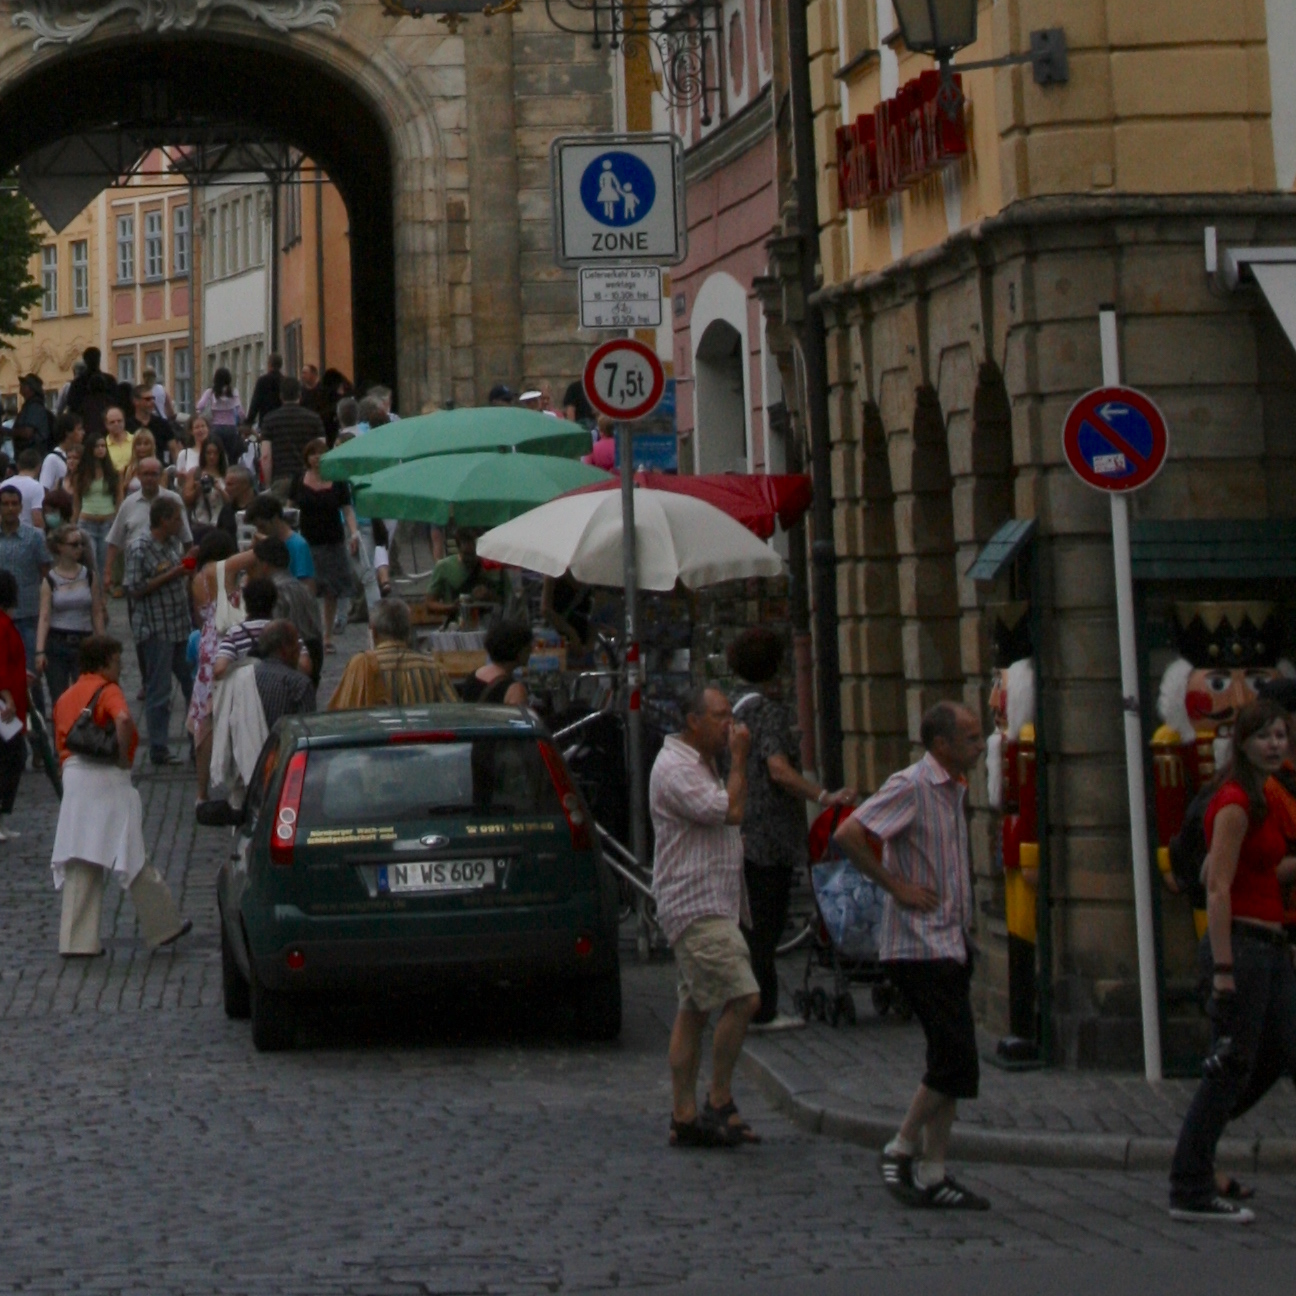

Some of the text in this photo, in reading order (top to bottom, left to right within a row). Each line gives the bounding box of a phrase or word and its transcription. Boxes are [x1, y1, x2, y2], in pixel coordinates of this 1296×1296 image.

[592, 232, 648, 251] ZONE
[604, 362, 645, 404] 7,5t
[394, 861, 486, 885] N WS 609
